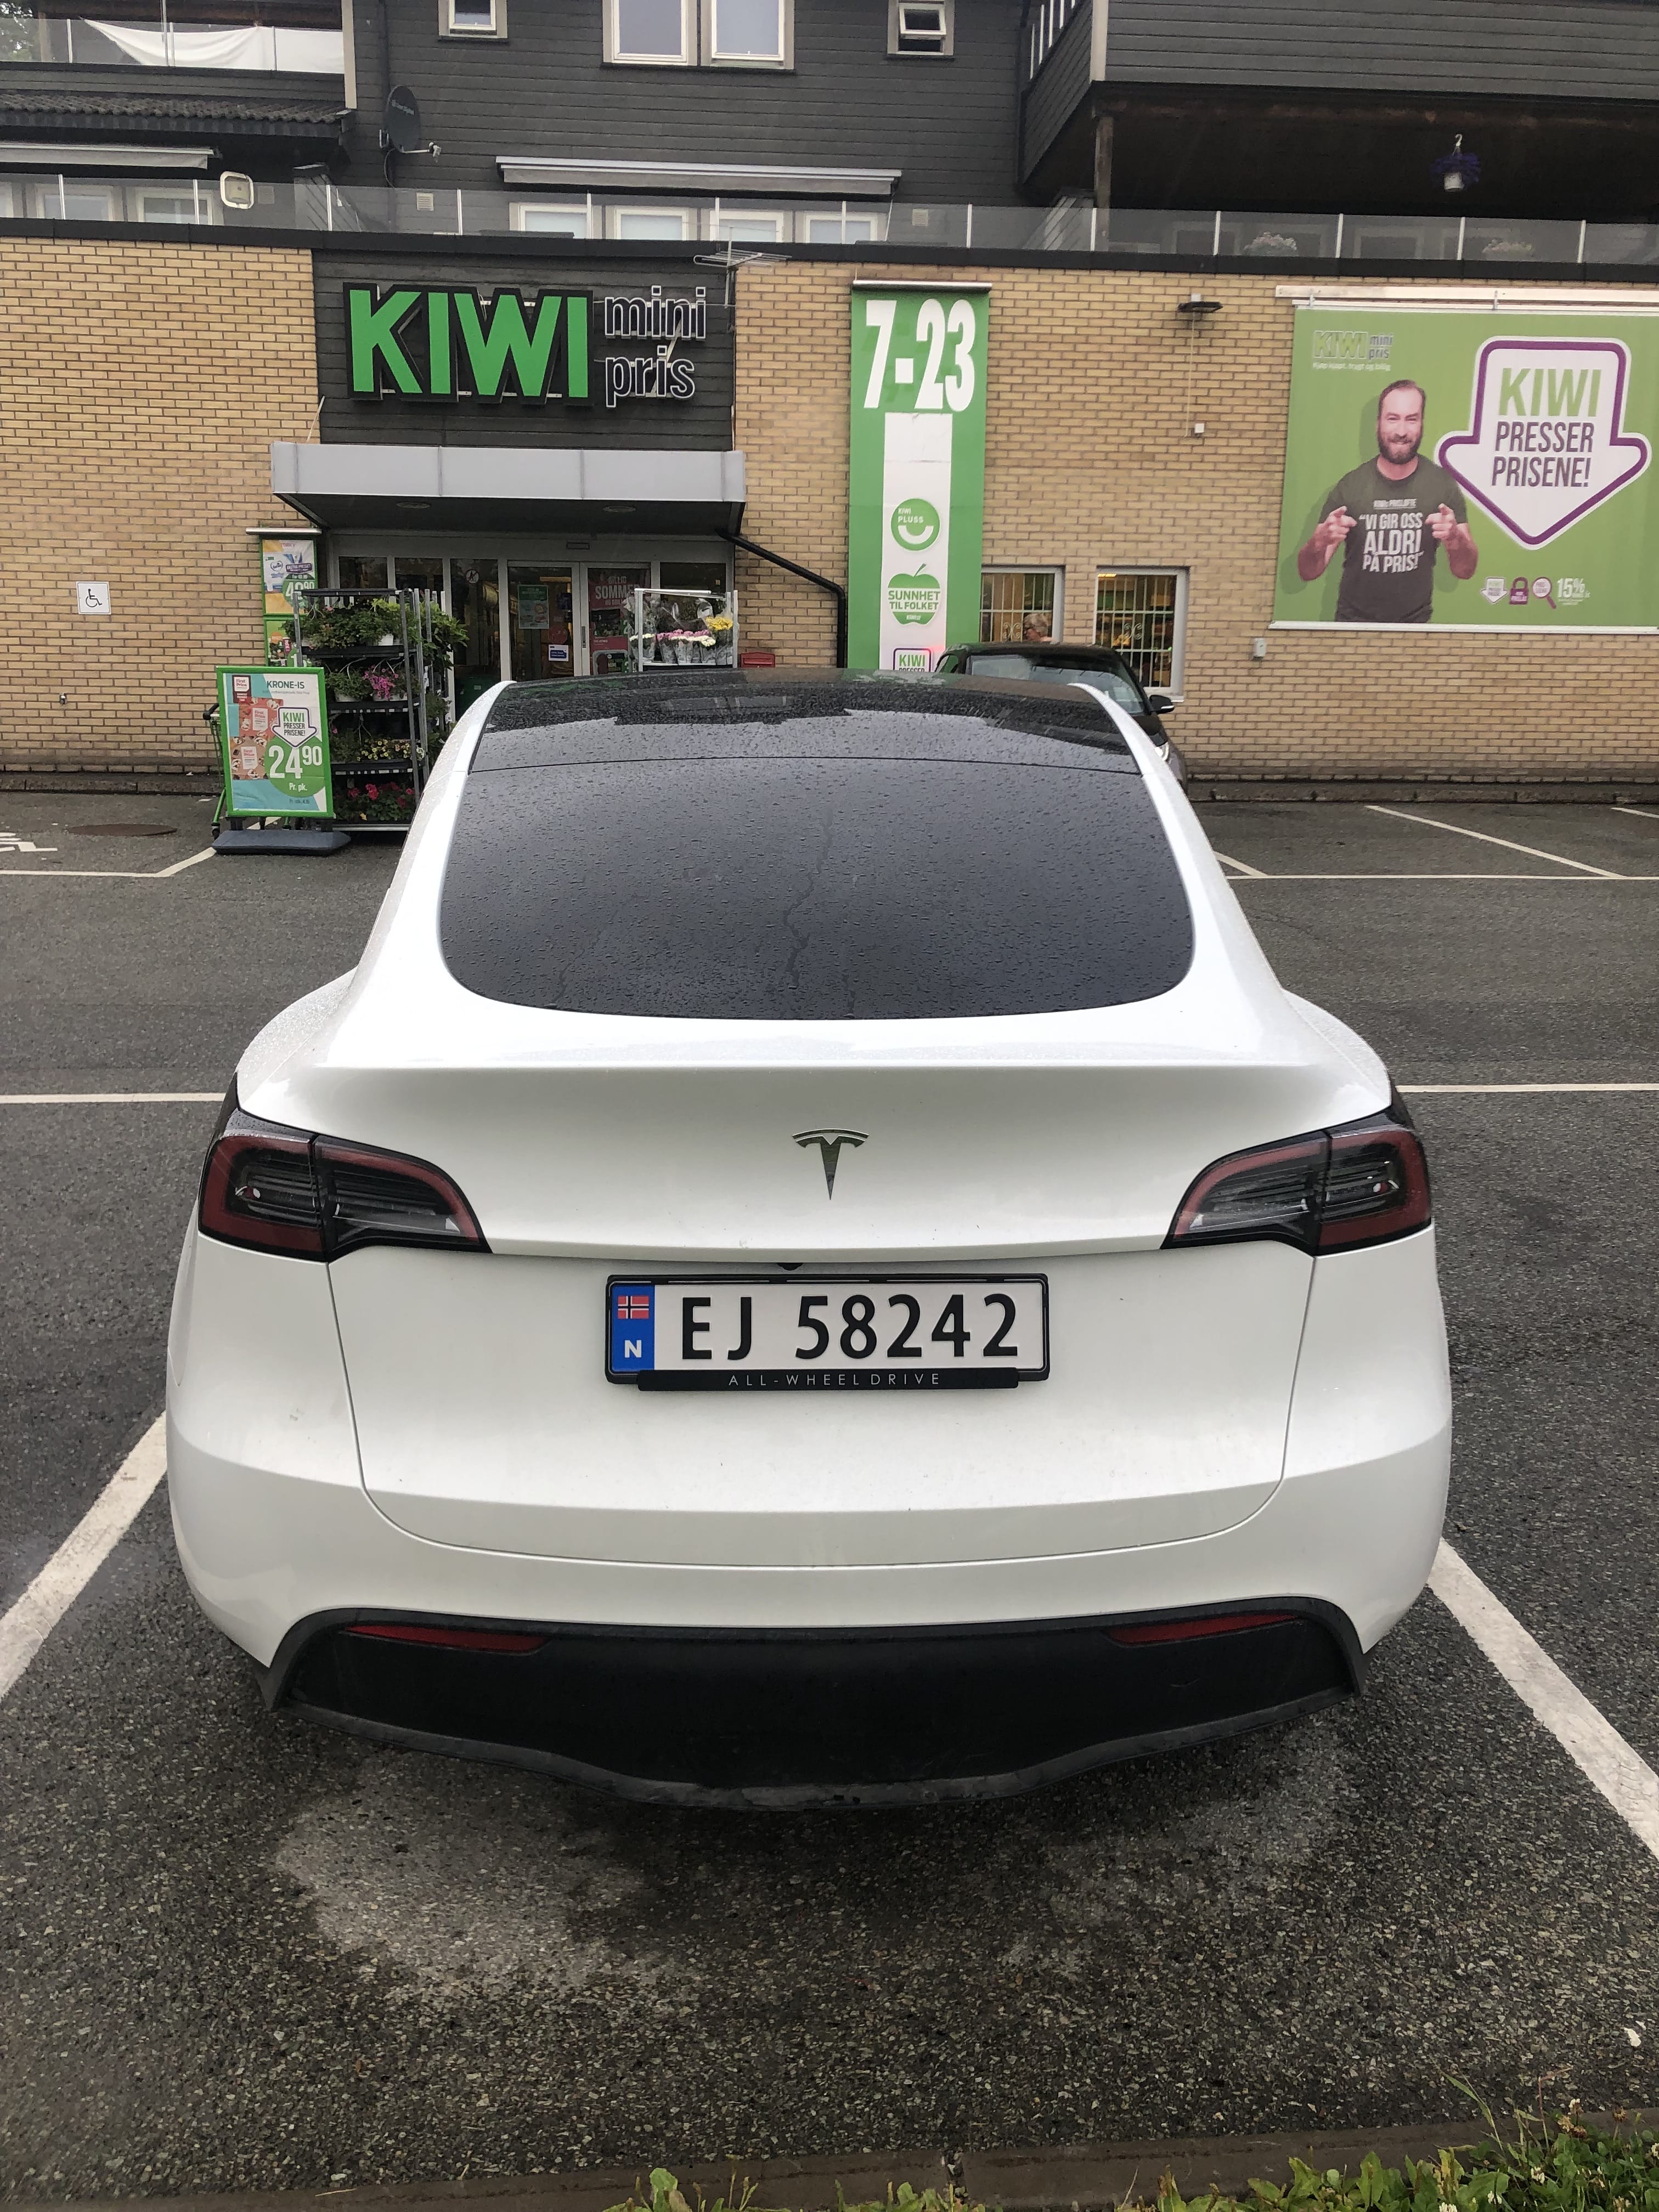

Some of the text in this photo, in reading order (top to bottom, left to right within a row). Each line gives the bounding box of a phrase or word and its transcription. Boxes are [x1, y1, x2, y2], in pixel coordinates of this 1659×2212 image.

[605, 285, 707, 340] mini
[348, 287, 590, 399] KIWI
[1313, 330, 1368, 359] KIWI
[1370, 334, 1394, 346] mini
[863, 297, 976, 412] 7-23
[1369, 348, 1390, 361] pris
[605, 345, 695, 408] pris
[1499, 367, 1602, 417] KIWI
[1494, 421, 1595, 453] PRESSER
[1491, 456, 1592, 488] PRISENE!
[1379, 514, 1399, 529] GIR
[1400, 512, 1423, 528] OSS
[1363, 529, 1423, 555] ALDRI
[1362, 551, 1380, 572] PÅ
[888, 590, 941, 601] SUNNHET
[1558, 578, 1585, 598] 15%
[890, 601, 939, 610] TIL FOLKET
[899, 654, 926, 667] KIWI
[267, 680, 305, 689] KRONE-IS
[283, 712, 304, 722] KIWI
[298, 783, 308, 792] pk.
[681, 1293, 1019, 1361] EJ 58242
[624, 1339, 642, 1358] N
